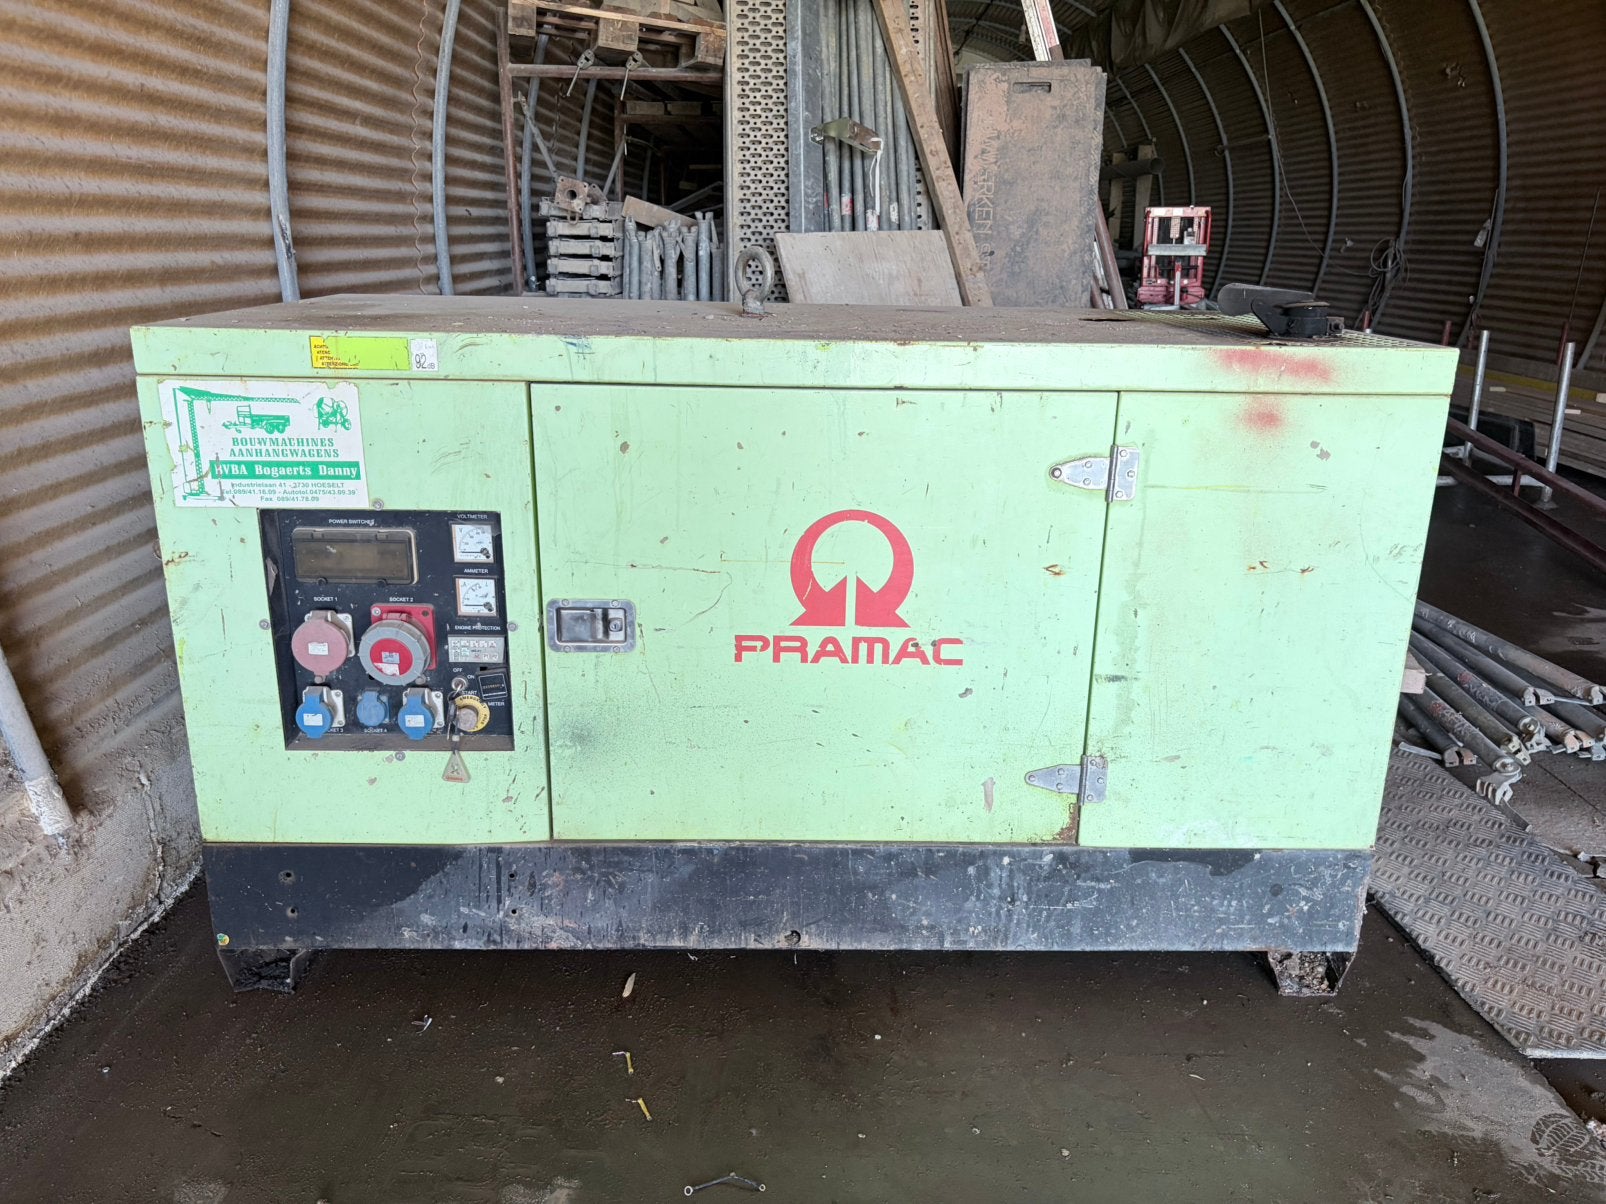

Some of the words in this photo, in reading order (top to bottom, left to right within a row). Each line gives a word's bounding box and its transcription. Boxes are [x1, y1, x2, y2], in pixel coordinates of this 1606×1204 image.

[232, 437, 335, 447] BOUWMACHINES
[229, 448, 340, 458] AANHANGWAGENS
[254, 464, 312, 478] Bogaerts
[318, 464, 358, 478] Danny
[734, 634, 964, 666] PRAMAC
